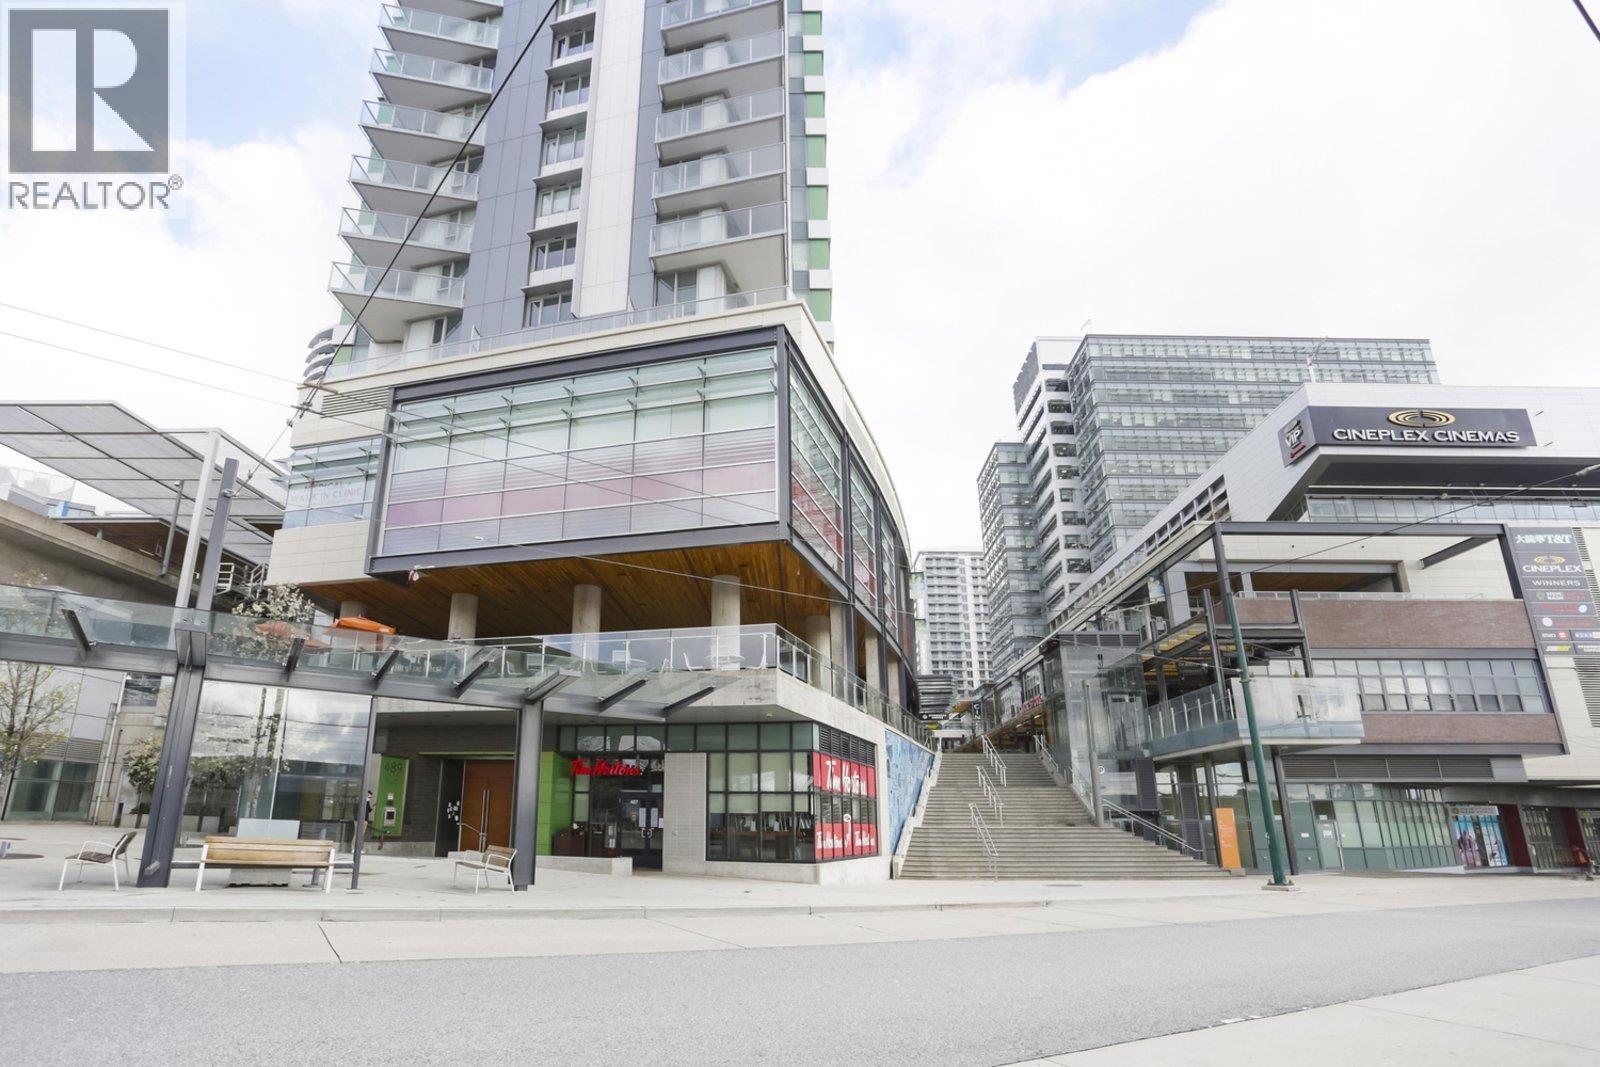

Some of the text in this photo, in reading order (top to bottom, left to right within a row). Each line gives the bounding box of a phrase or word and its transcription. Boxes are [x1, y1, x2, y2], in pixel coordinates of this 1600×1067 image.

[1284, 429, 1302, 448] VIP
[1332, 428, 1520, 443] CINEPLEX CINEMAS
[332, 486, 362, 498] CLINIC
[1522, 564, 1582, 573] CINEPLEX
[1532, 579, 1581, 587] WINNERS
[384, 761, 403, 774] 489
